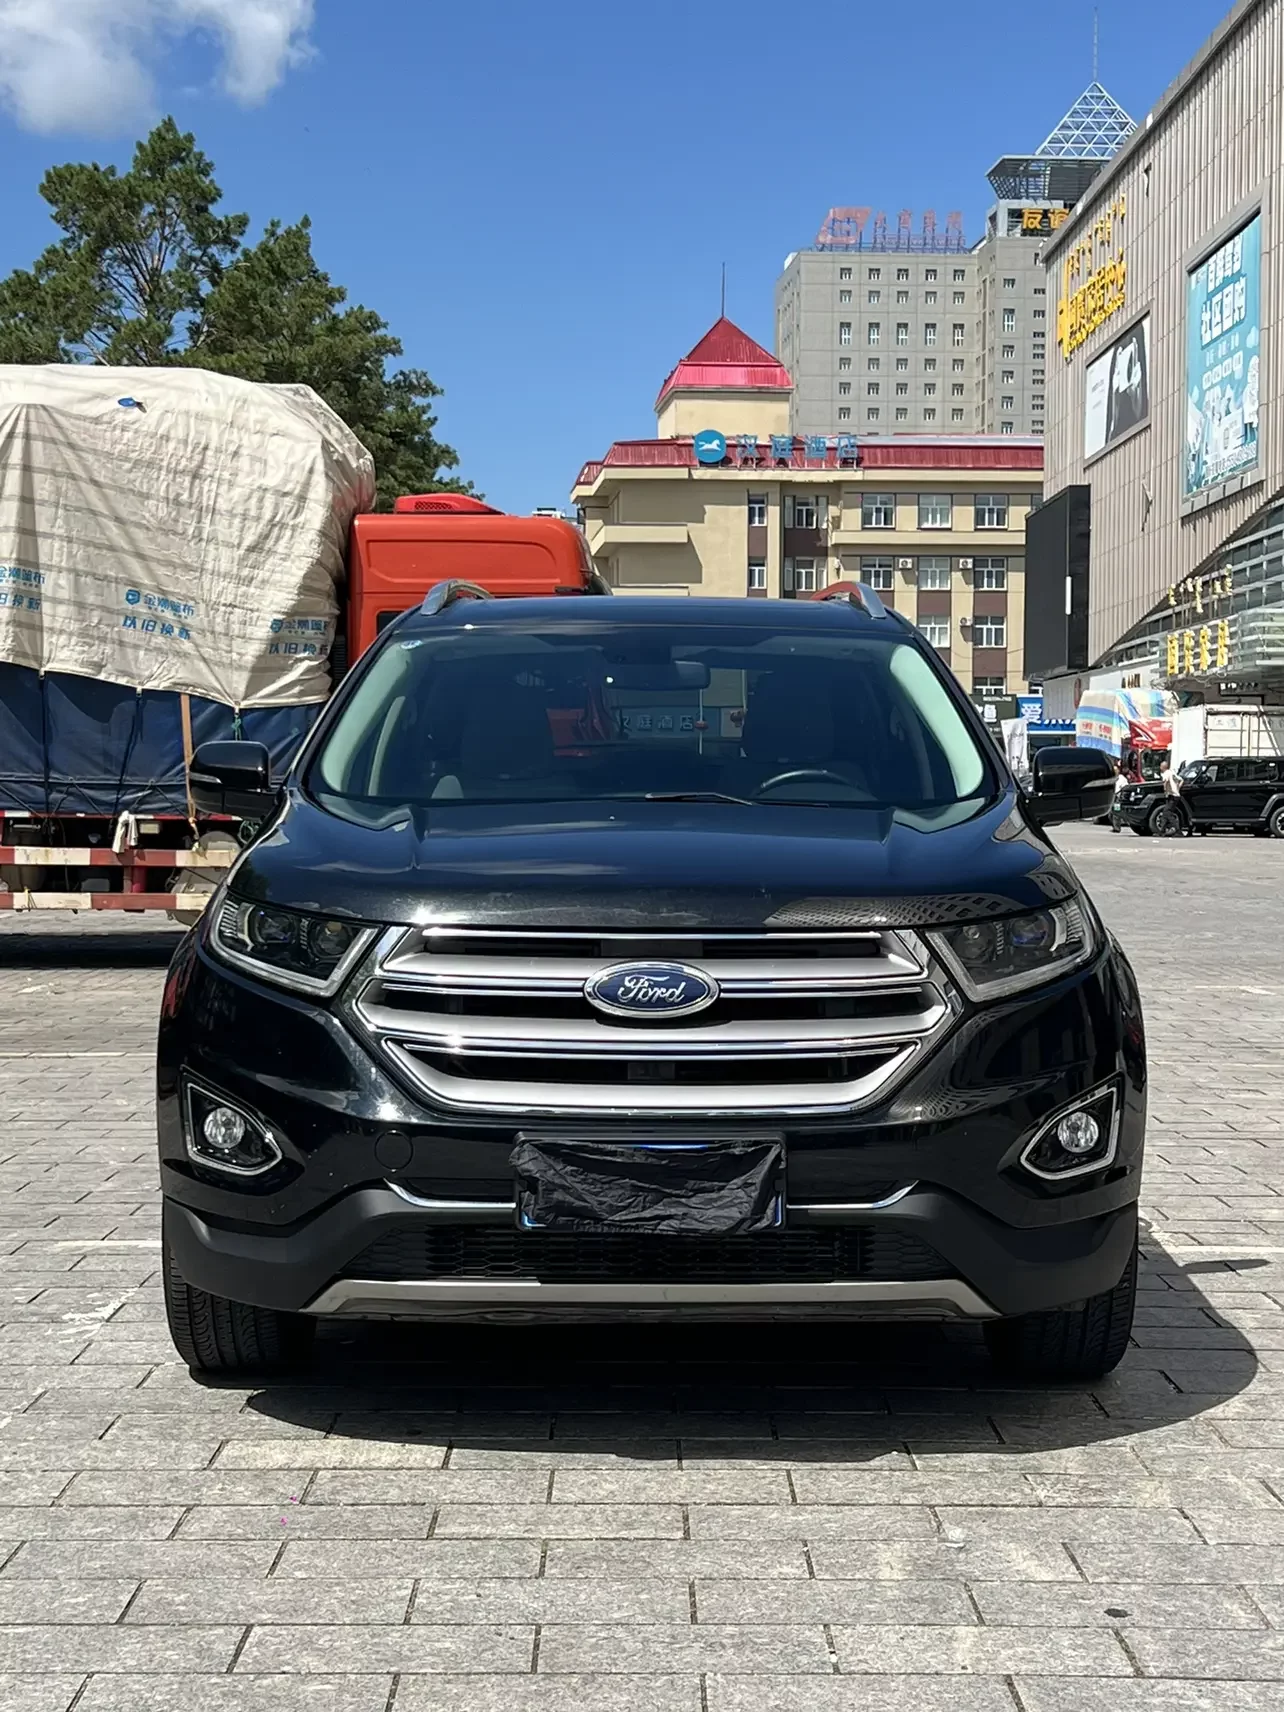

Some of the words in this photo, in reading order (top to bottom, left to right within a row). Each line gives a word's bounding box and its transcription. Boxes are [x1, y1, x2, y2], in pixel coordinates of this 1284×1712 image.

[736, 434, 859, 458] 汉庭酒店
[122, 615, 191, 640] 以旧换新
[617, 973, 686, 1003] Ford
